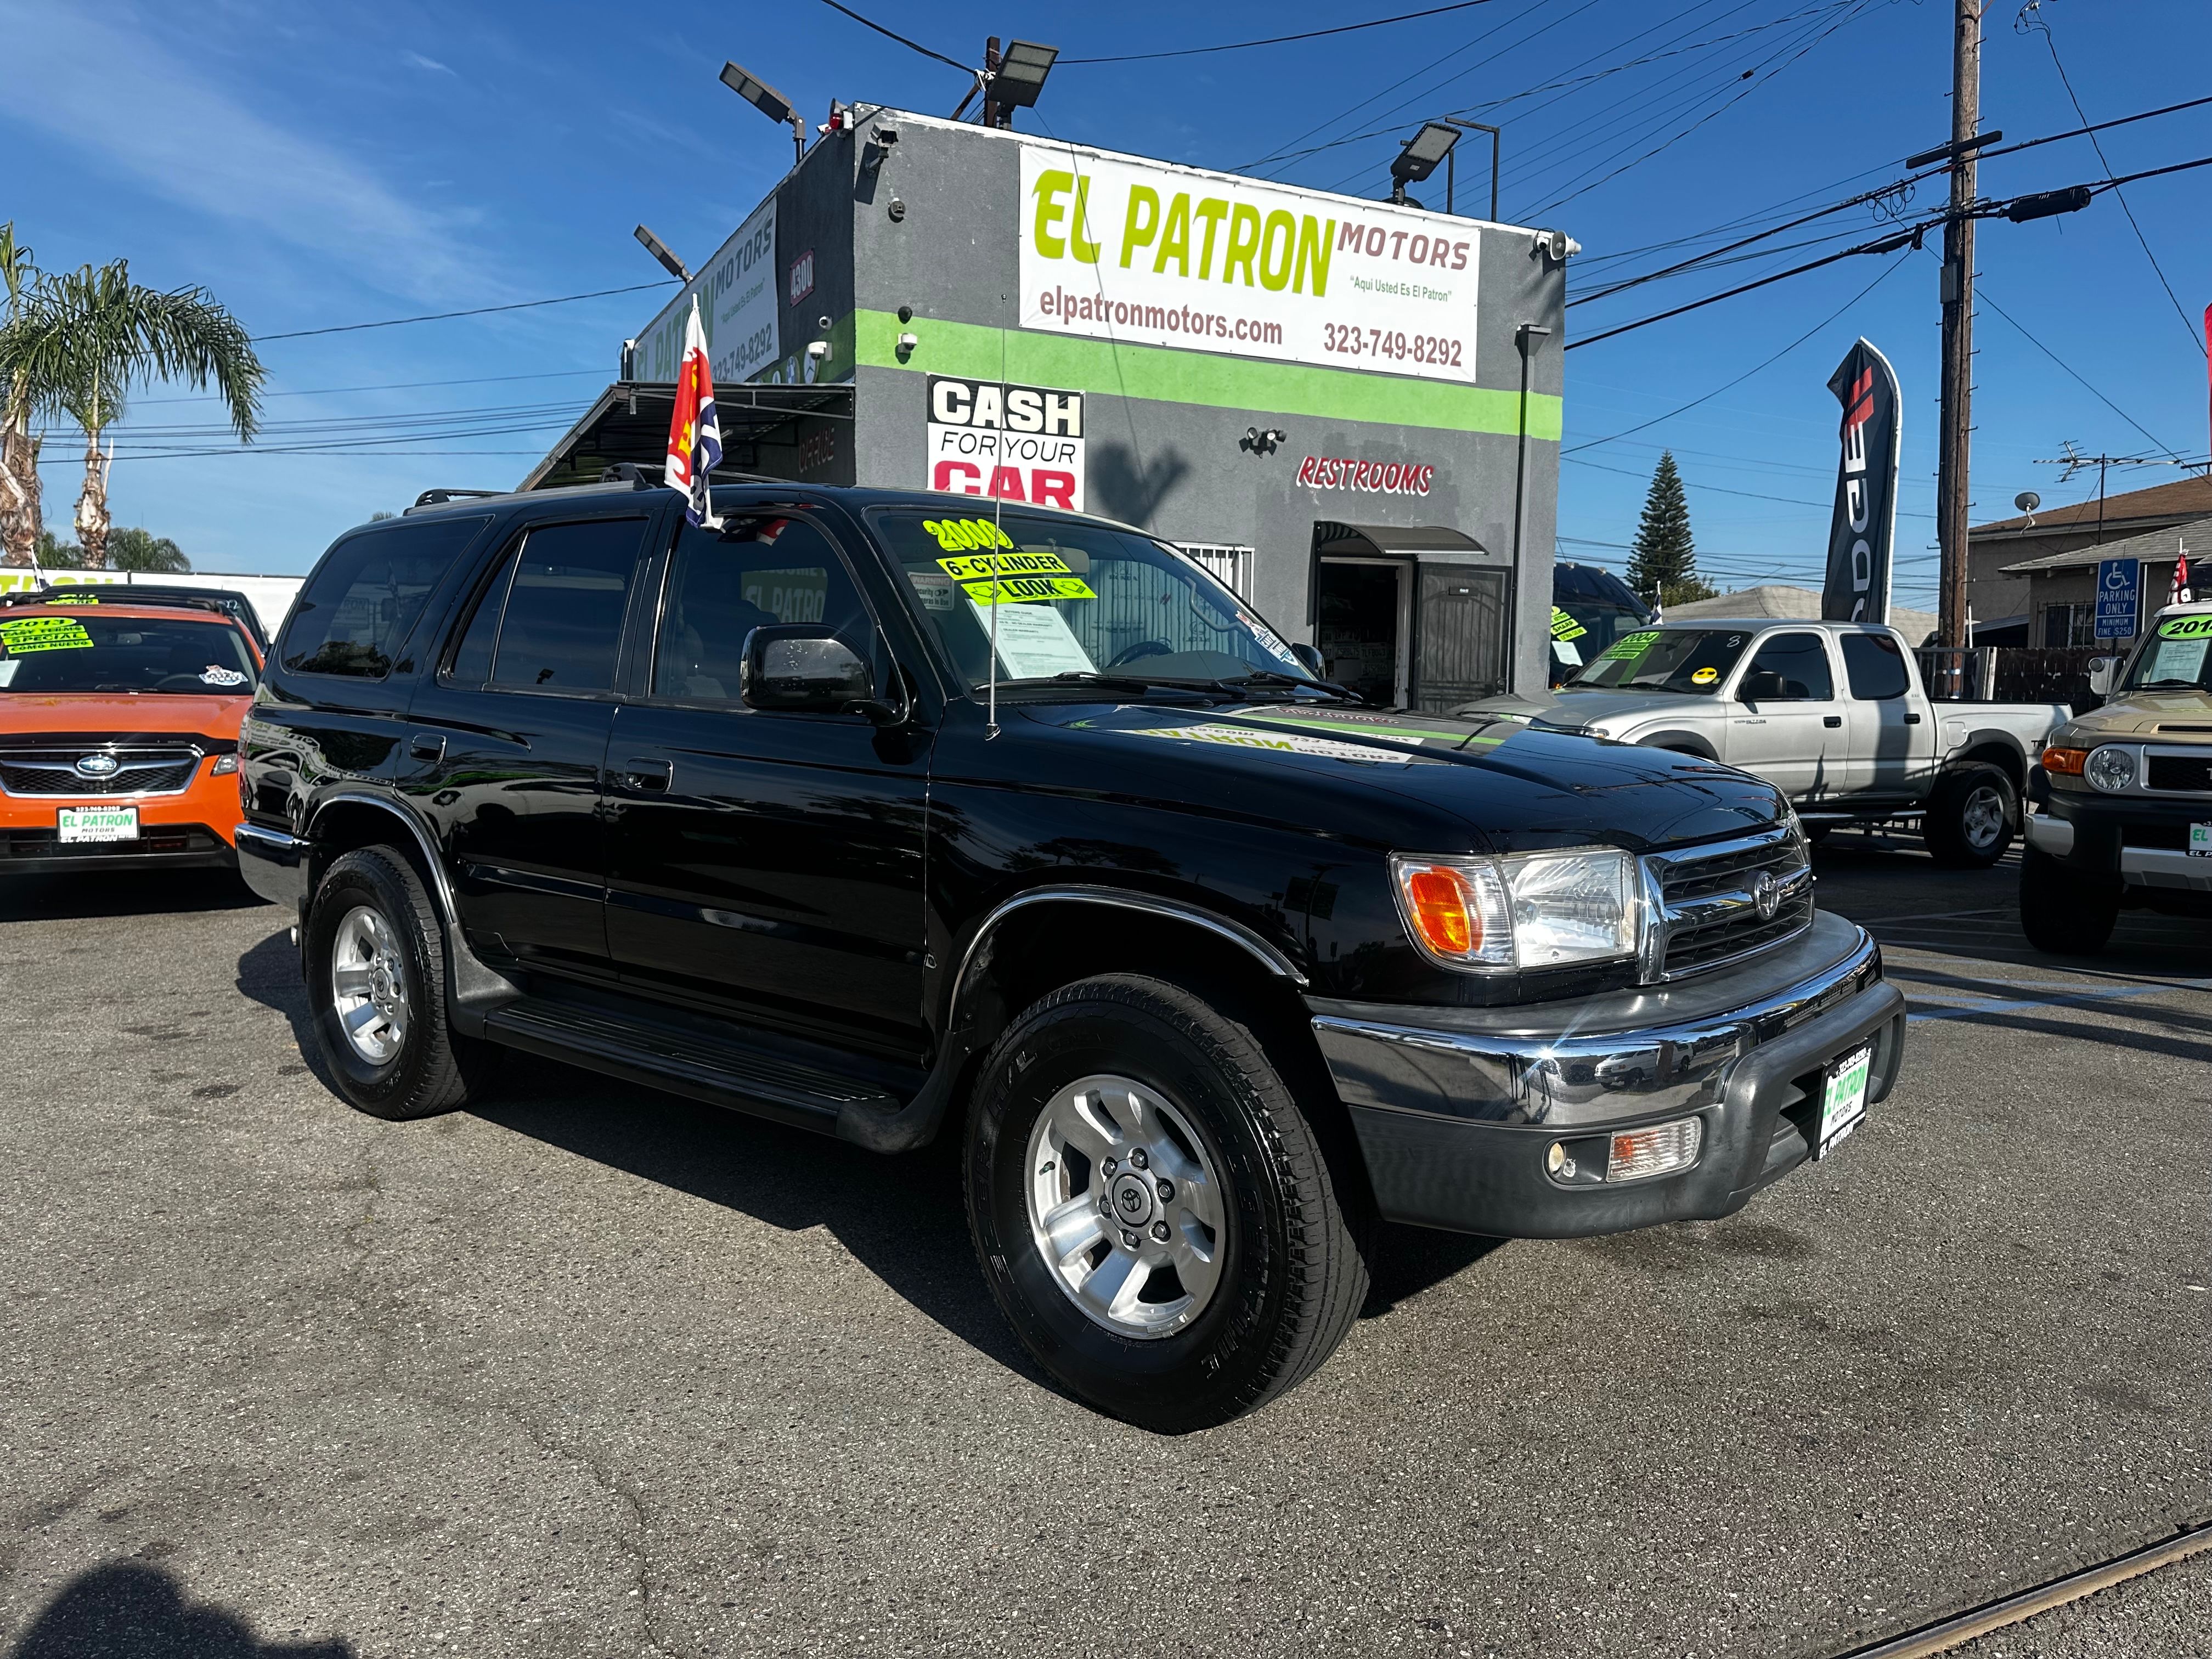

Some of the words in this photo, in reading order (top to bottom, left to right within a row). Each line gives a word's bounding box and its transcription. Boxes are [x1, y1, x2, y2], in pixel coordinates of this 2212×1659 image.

[1031, 169, 1101, 264] EL
[1119, 184, 1336, 298] PATRON
[1338, 222, 1470, 270] MOTORS
[715, 218, 773, 300] MOTORS
[791, 254, 814, 300] 4300
[1375, 279, 1398, 294] Usted
[1401, 283, 1410, 296] Es
[1413, 285, 1420, 298] El
[1040, 286, 1283, 346] elpatronmotors.com
[1324, 323, 1463, 368] 323-749-8292
[933, 380, 1081, 437] CASH
[941, 431, 997, 456] FOR
[1005, 437, 1076, 464] YOUR
[934, 460, 1076, 511] CAR
[1296, 456, 1435, 496] RESTROOMS
[923, 518, 1014, 551] 2000
[945, 555, 1066, 576] 6-CYLINDER
[912, 577, 950, 586] WARNING
[1001, 579, 1064, 599] LOOK
[2099, 589, 2135, 602] PARKING
[2105, 601, 2127, 615] ONLY
[1552, 620, 1573, 633] SHARP
[2097, 627, 2112, 636] FINE
[2113, 627, 2132, 636] $250
[2102, 618, 2129, 627] MINIMUM
[12, 634, 77, 643] SPECIAL
[63, 815, 77, 827] EL
[82, 814, 133, 827] PATRON
[2192, 829, 2208, 842] EL
[1823, 1086, 1833, 1119] EL
[1833, 1062, 1868, 1110] PATRON
[1831, 1101, 1853, 1126] MOTORS
[1819, 1142, 1827, 1160] EL
[1829, 1124, 1854, 1152] PATRON
